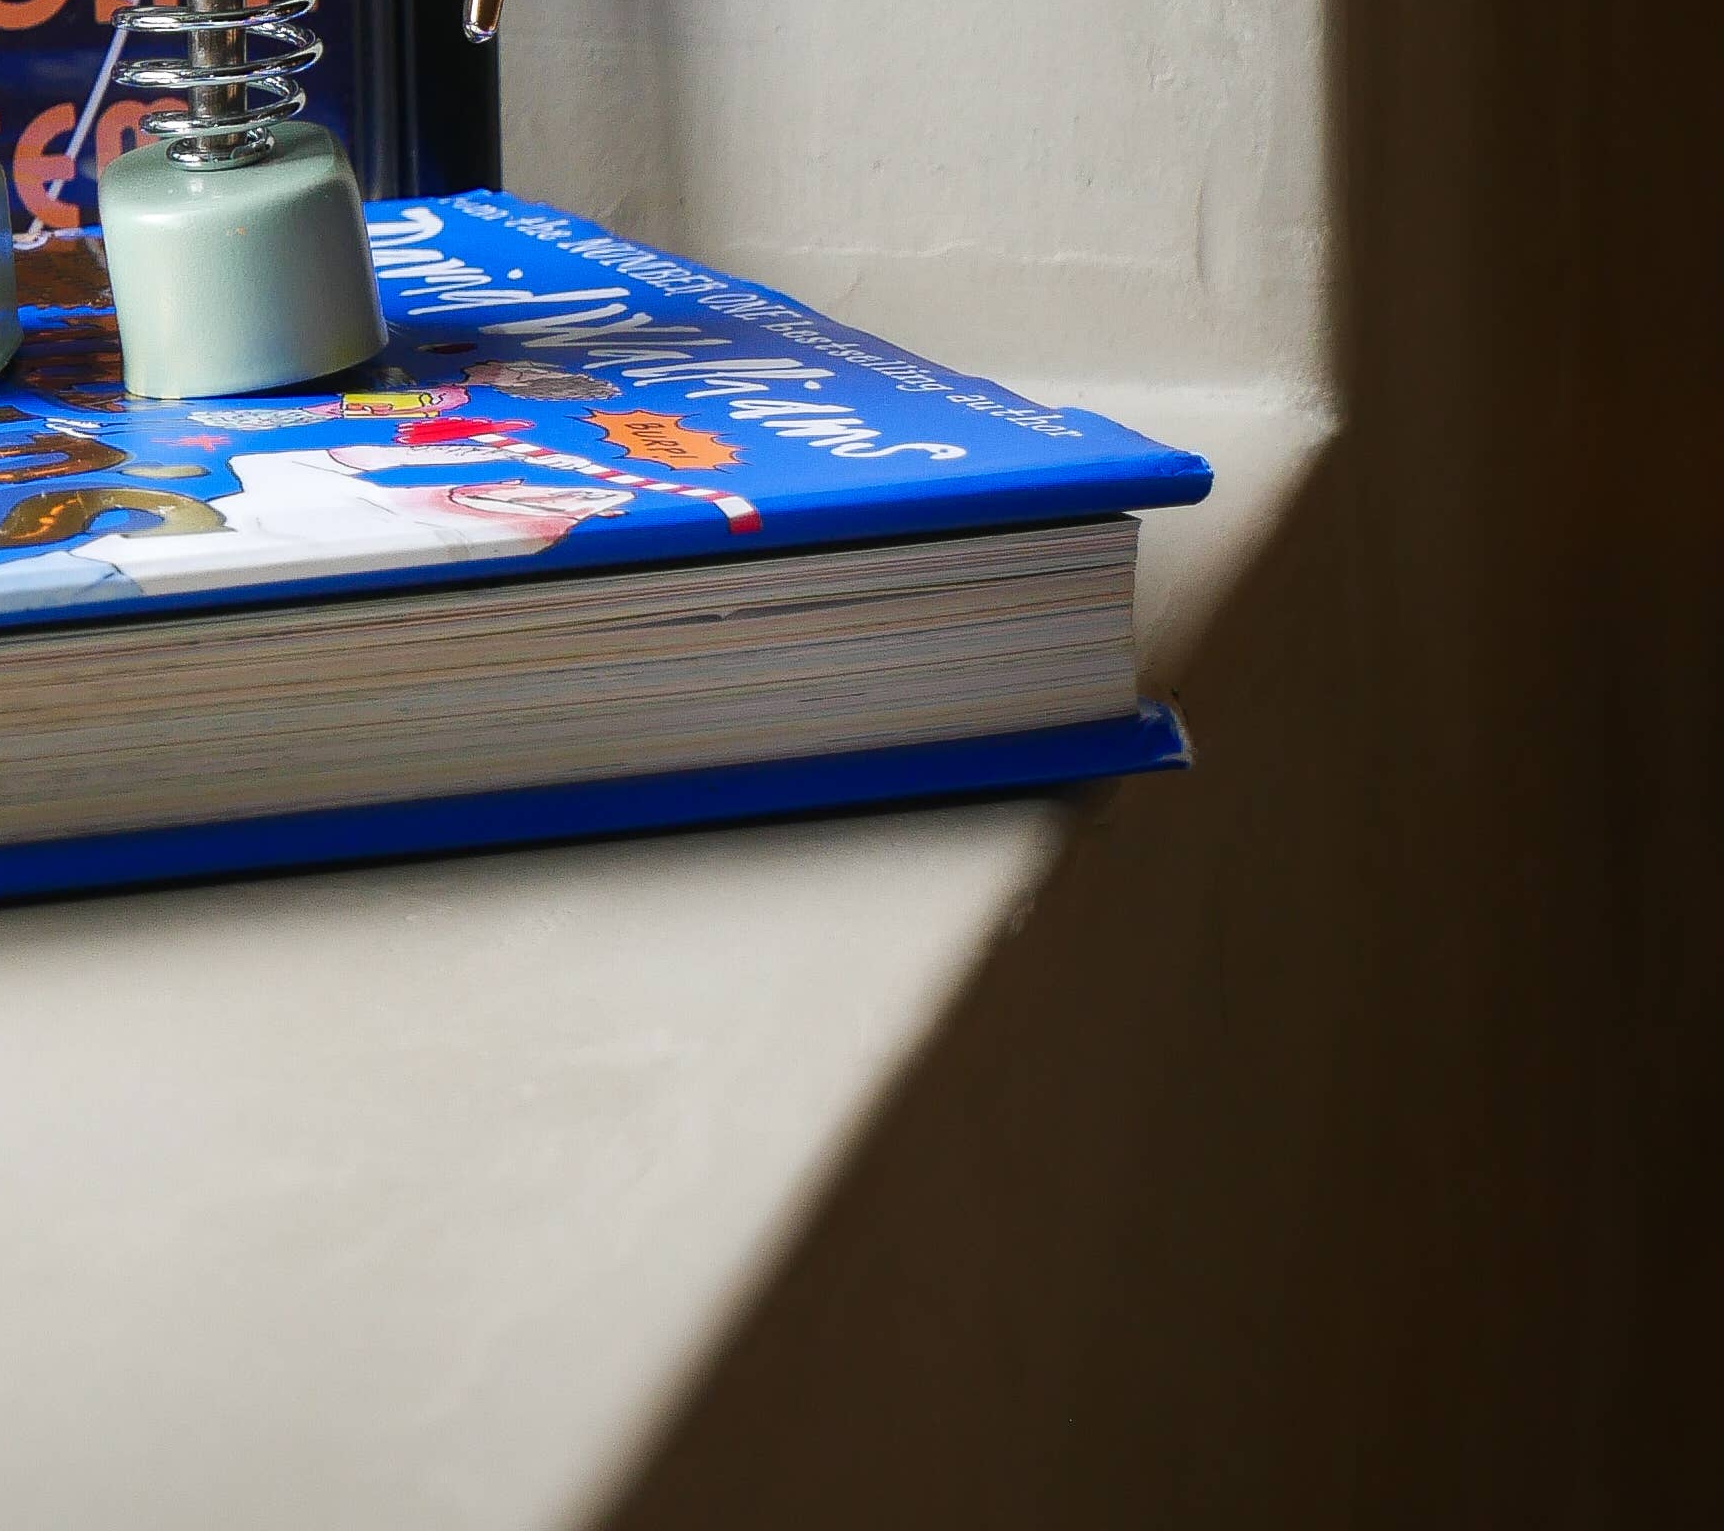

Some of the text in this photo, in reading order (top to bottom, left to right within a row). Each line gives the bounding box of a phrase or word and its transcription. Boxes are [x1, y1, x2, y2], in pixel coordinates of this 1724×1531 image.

[477, 302, 968, 461] Walliams
[503, 215, 573, 241] the
[556, 237, 729, 297] NUMBER
[697, 291, 802, 322] ONE
[759, 317, 956, 393] bestselling
[945, 391, 1084, 438] author
[624, 422, 699, 459] BURP!
